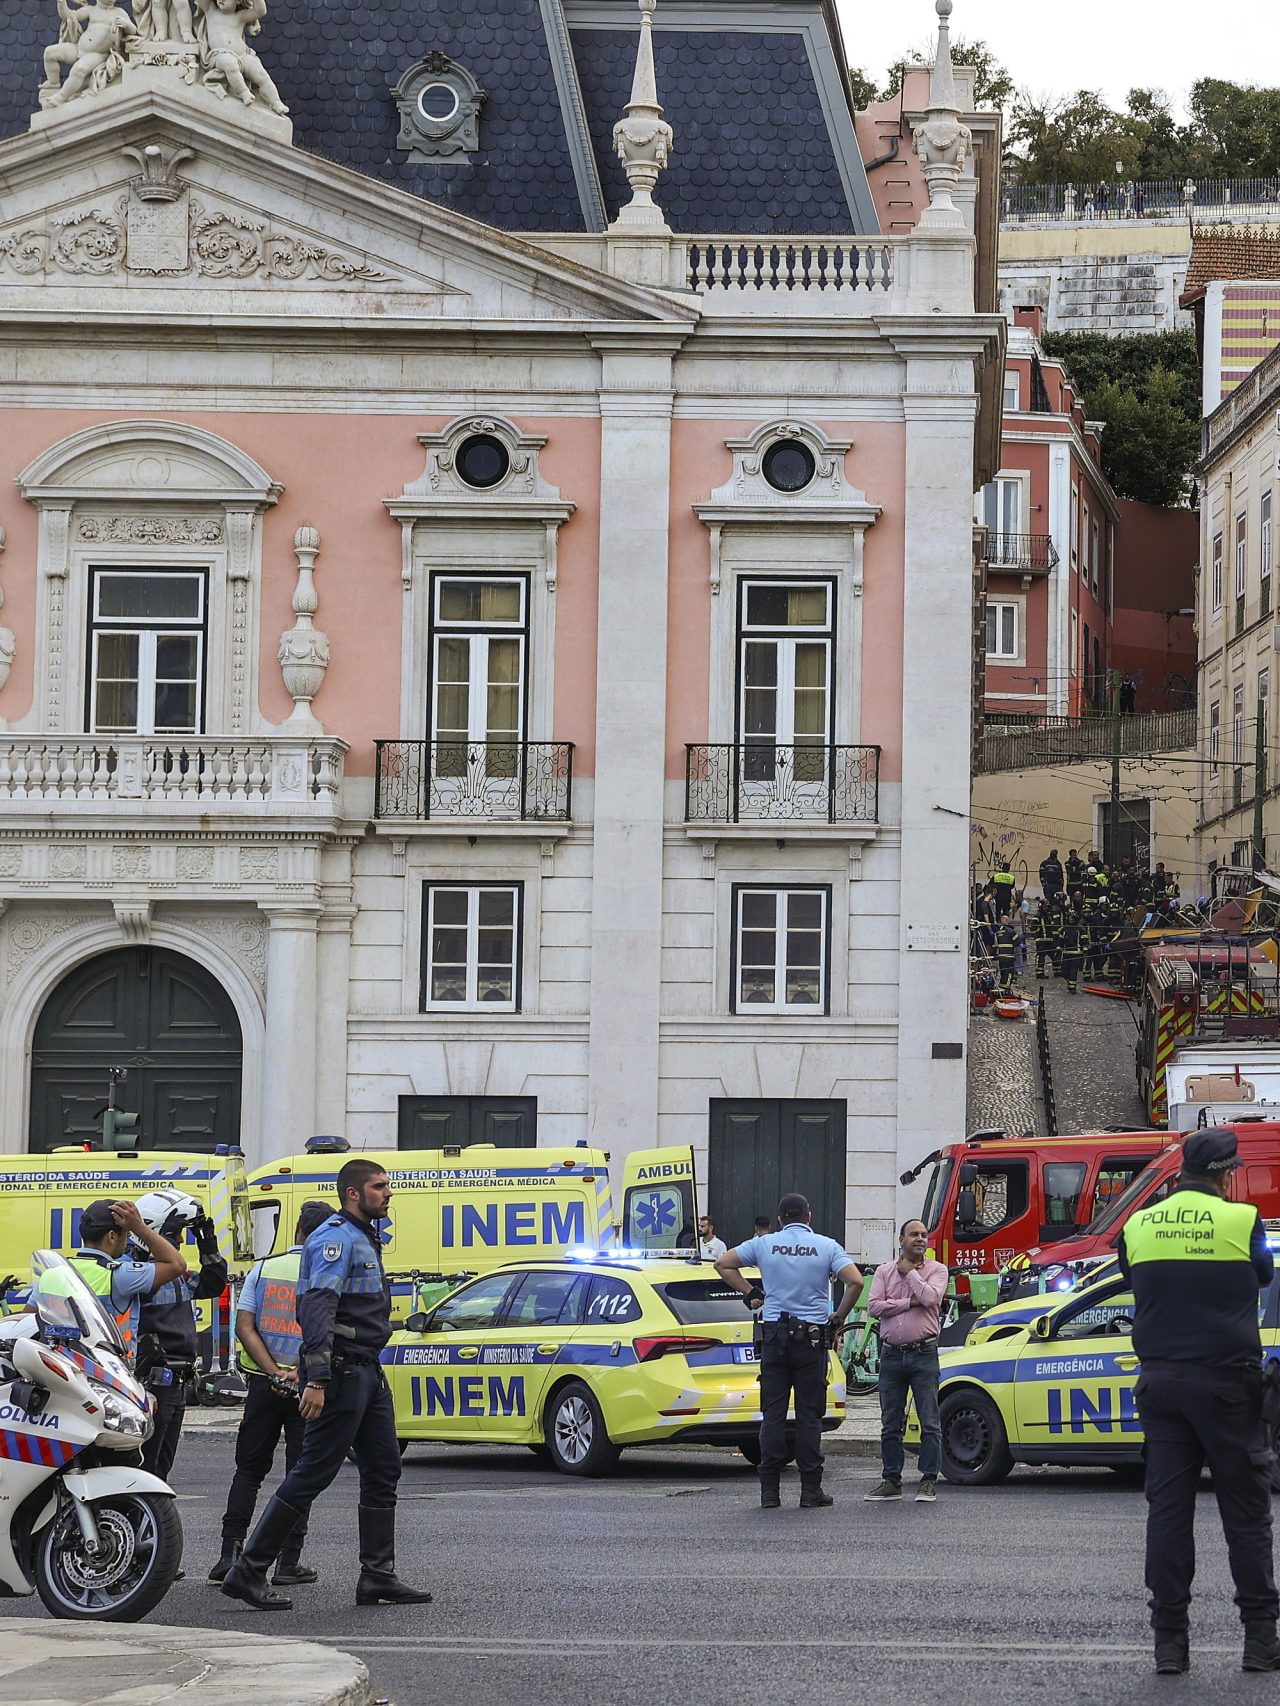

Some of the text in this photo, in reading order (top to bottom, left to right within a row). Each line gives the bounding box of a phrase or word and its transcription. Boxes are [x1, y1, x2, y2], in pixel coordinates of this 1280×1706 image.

[49, 1173, 65, 1181] DA
[68, 1170, 110, 1180] SAÚDE
[441, 1171, 457, 1179] DA
[38, 1182, 52, 1190] DE
[56, 1180, 129, 1190] EMERGÊNCIA
[132, 1180, 175, 1190] MÉDICA
[431, 1180, 445, 1188] DE
[455, 1178, 515, 1188] EMERGÊNCIA
[519, 1177, 556, 1187] MÉDICA
[1141, 1206, 1214, 1227] POLÍCIA
[441, 1201, 585, 1247] INEM
[1155, 1229, 1214, 1241] municipal
[771, 1243, 819, 1257] POLÍCIA
[956, 1249, 985, 1258] 2101
[1184, 1246, 1215, 1255] Lisboa
[955, 1258, 986, 1266] VSAT
[262, 1315, 303, 1336] TRÂNS
[403, 1346, 450, 1364] EMERGÊNCIA
[483, 1345, 534, 1363] MINISTÉRIO DA SAÚDE
[1035, 1358, 1104, 1375] EMERGÊNCIA
[411, 1376, 526, 1417] INEM
[1047, 1387, 1144, 1434] INE
